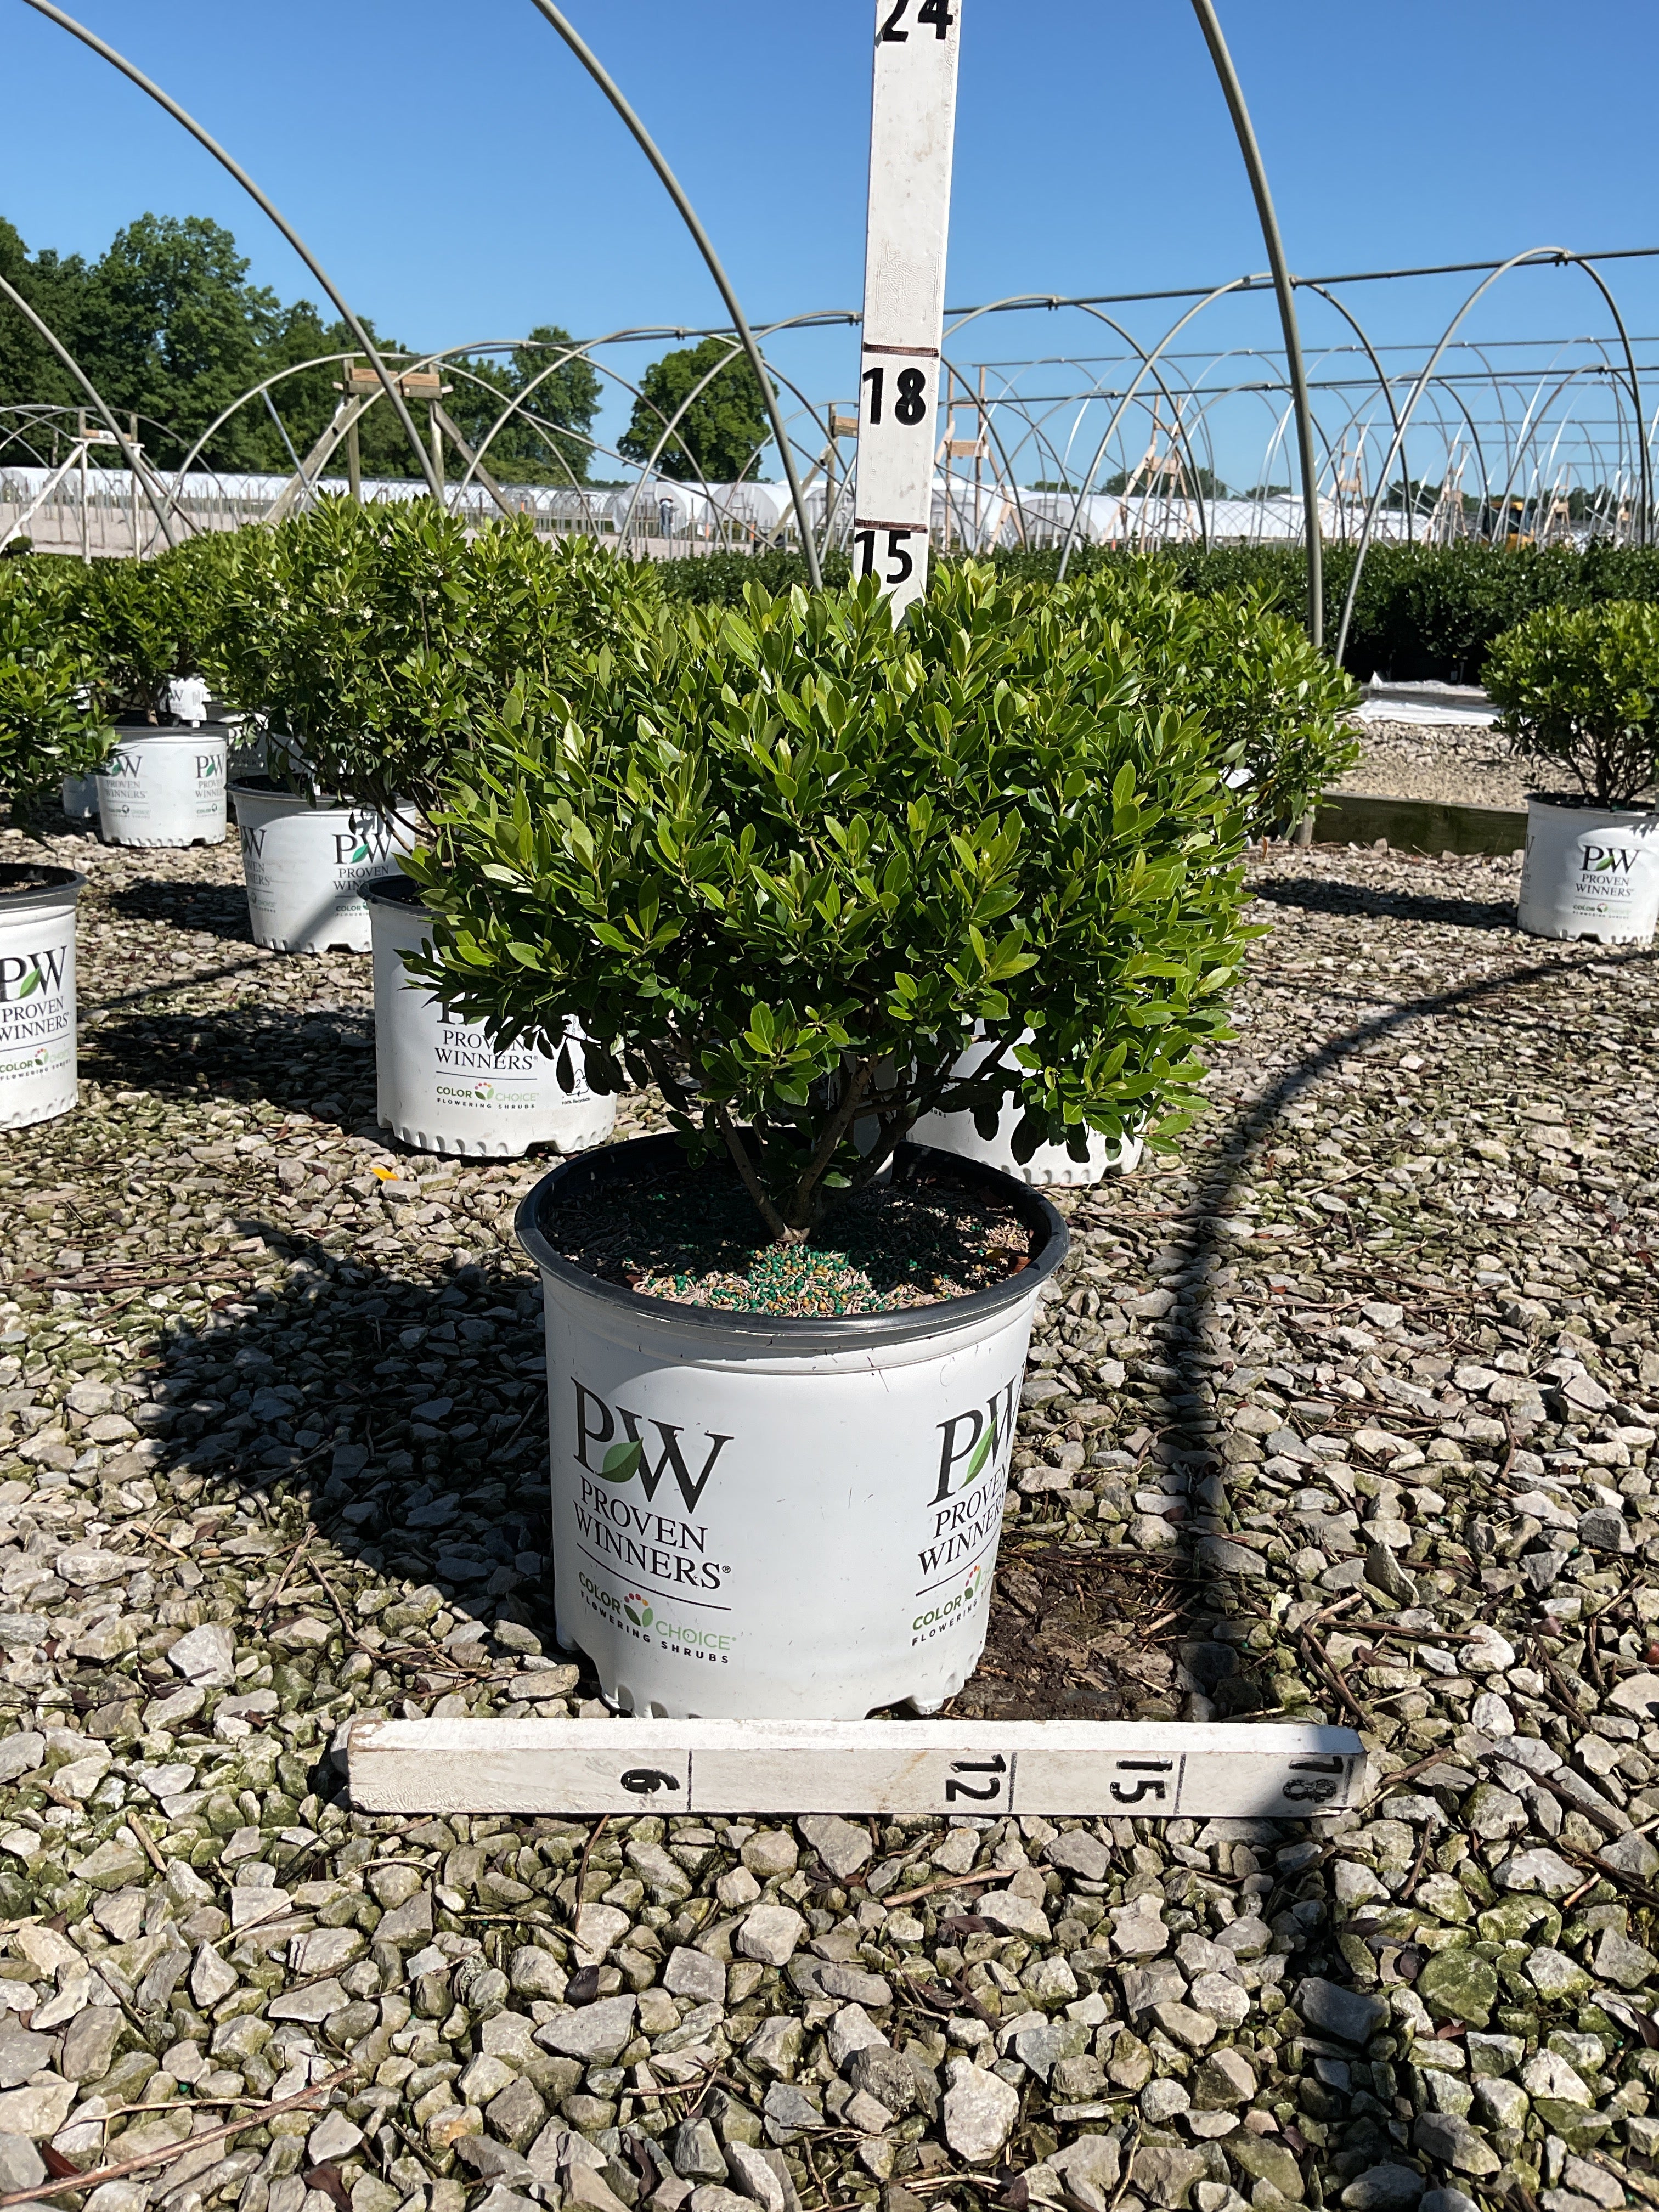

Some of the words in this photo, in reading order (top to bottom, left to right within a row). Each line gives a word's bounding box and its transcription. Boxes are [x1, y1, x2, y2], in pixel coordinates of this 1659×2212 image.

[874, 0, 953, 43] 24
[862, 367, 926, 426] 18
[854, 530, 913, 584] 15
[194, 753, 225, 778] PW
[106, 780, 140, 789] PROVEN
[332, 833, 392, 865] PW
[1579, 845, 1640, 875] PW
[338, 865, 389, 878] PROVEN
[1582, 873, 1630, 887] PROVEN
[1575, 883, 1632, 897] WINNERS
[0, 945, 67, 1003] PW
[2, 995, 64, 1023] PROVEN
[0, 1013, 69, 1042] WINNERS
[443, 1029, 526, 1051] PROVN
[0, 1060, 33, 1073] COLOR
[575, 1079, 581, 1088] 2
[436, 1086, 472, 1098] COLOR
[495, 1092, 537, 1102] CHOICE
[437, 1098, 492, 1109] FLOWERING
[570, 1375, 735, 1514] PW
[927, 1357, 1027, 1508] PW
[580, 1475, 708, 1553] PROVEN
[933, 1455, 1008, 1540] PROVEN
[579, 1571, 621, 1615] COLOR
[655, 1620, 731, 1651] CHOICE
[580, 1590, 651, 1643] FLOWERING
[661, 1640, 729, 1664] SHRUBS
[911, 1598, 978, 1646] FLOWERING
[912, 1594, 962, 1631] COLOR
[620, 1768, 681, 1794] 6
[945, 1754, 1006, 1802] 12
[1109, 1759, 1173, 1804] 15
[1283, 1755, 1344, 1804] 18
